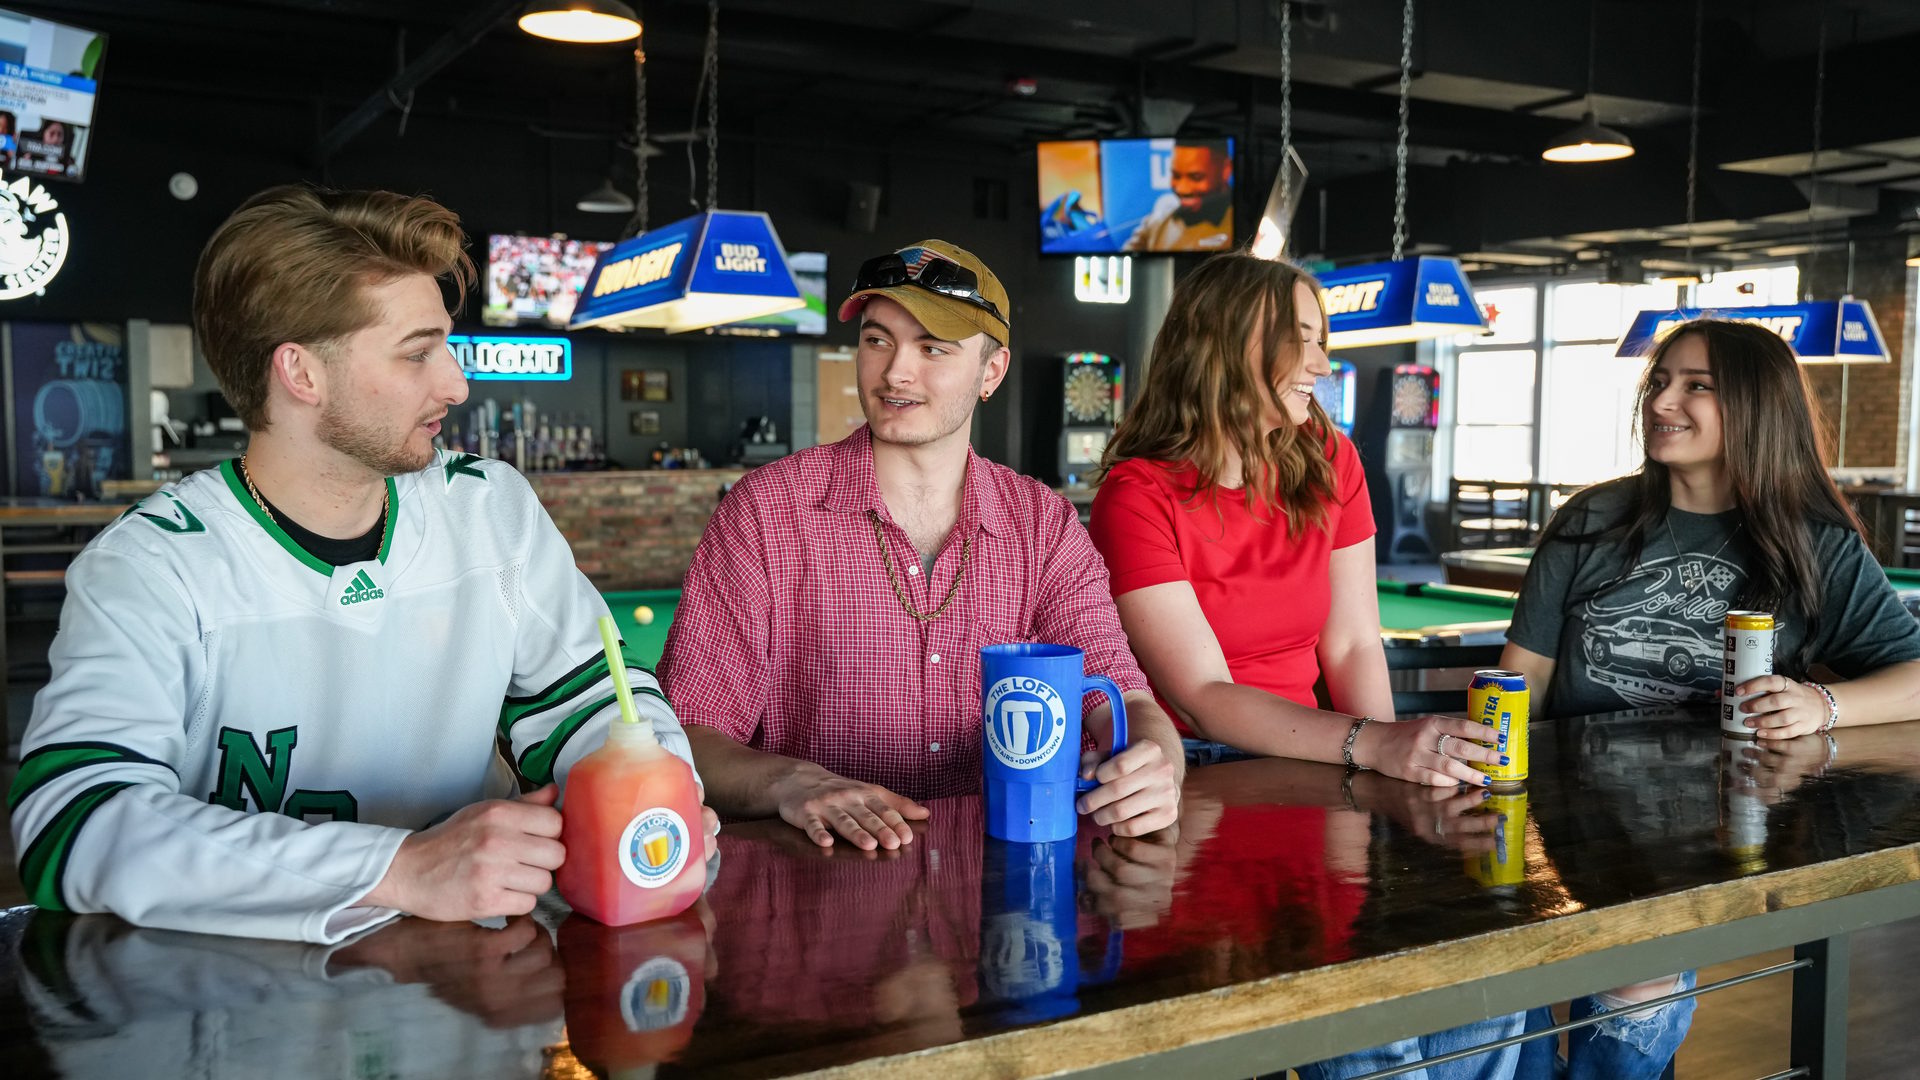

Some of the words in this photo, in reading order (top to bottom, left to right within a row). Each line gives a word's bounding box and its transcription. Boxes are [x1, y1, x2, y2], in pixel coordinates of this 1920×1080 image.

[0, 168, 58, 214] LAW
[715, 255, 767, 273] LIGHT
[720, 243, 759, 258] BUD
[1319, 280, 1385, 316] IGHT
[457, 342, 563, 374] LIGHT
[340, 586, 384, 606] adidas
[1583, 566, 1731, 624] Corve
[991, 683, 1009, 700] THE
[1012, 678, 1058, 701] LOFT
[1484, 695, 1500, 716] TEA
[1499, 715, 1510, 748] OINAL
[989, 733, 1015, 762] UPSTAIRS
[1018, 735, 1060, 765] DOWNTOWN
[634, 826, 647, 841] THE
[646, 817, 674, 829] LOFT
